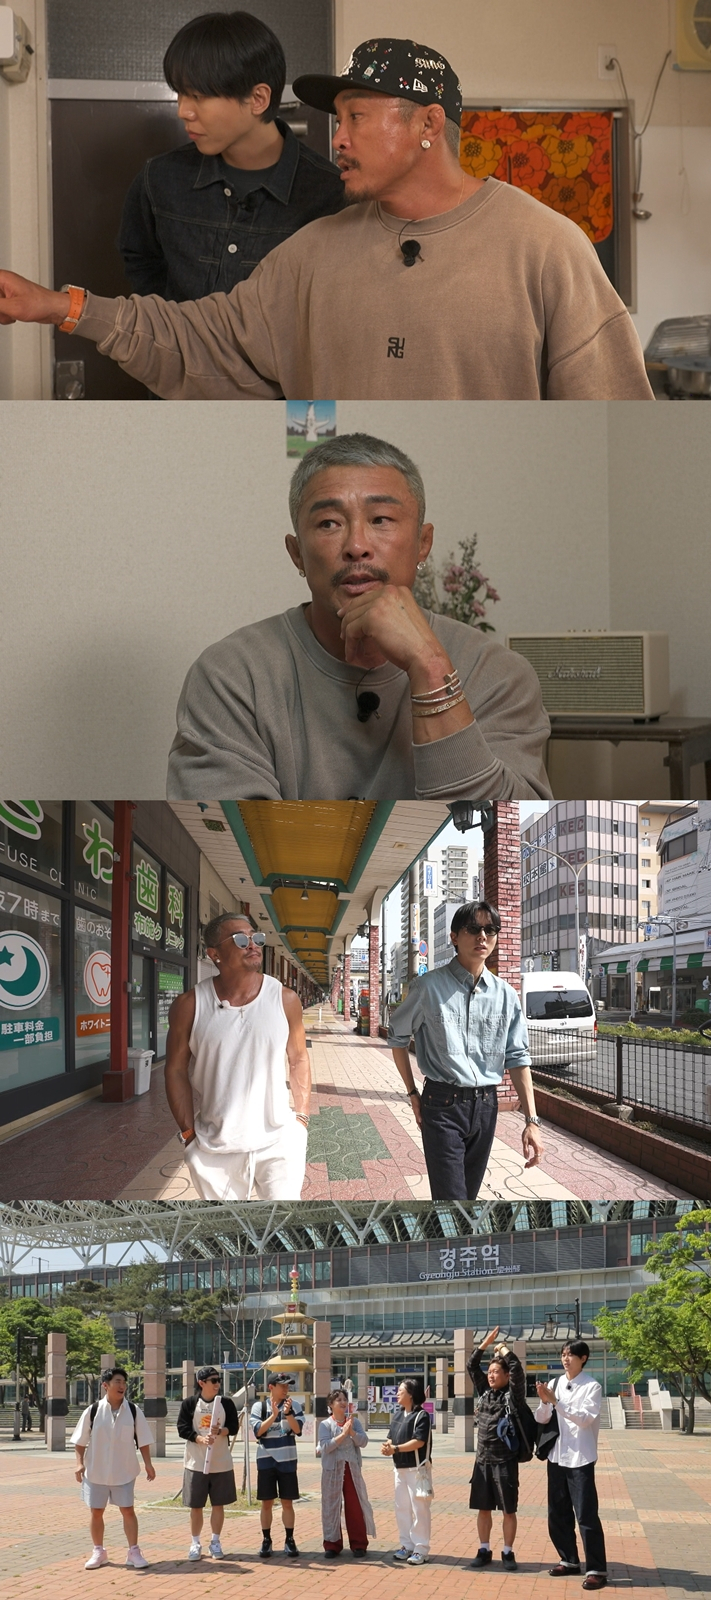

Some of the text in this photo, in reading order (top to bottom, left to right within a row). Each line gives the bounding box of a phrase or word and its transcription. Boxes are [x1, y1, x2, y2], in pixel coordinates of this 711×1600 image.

[560, 818, 584, 835] KEC
[559, 850, 585, 867] KEC
[560, 882, 585, 897] KEC
[1, 1020, 45, 1035] 駐車料金
[13, 1031, 54, 1045] 一部負担
[439, 1244, 500, 1271] 경주역
[419, 1269, 460, 1281] Gyeongju
[462, 1268, 494, 1277] Station
